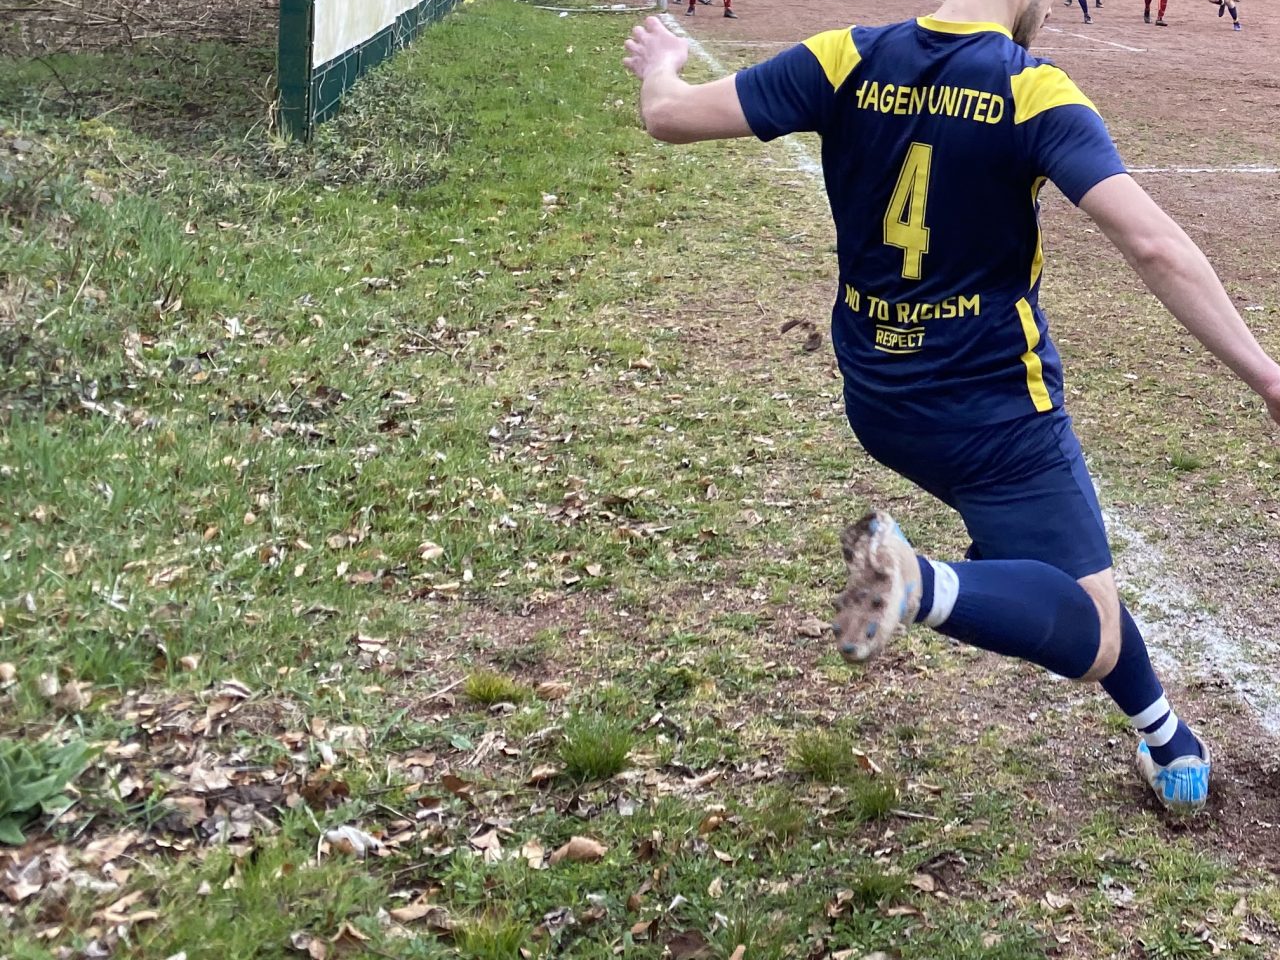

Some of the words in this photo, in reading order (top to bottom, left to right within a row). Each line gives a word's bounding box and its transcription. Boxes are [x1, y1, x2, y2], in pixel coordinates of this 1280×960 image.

[855, 80, 927, 115] HAGEN
[928, 85, 1004, 124] UNITED
[882, 141, 933, 281] 4
[844, 283, 860, 313] NO
[867, 295, 890, 321] TO
[895, 293, 980, 324] RACISM
[875, 329, 925, 348] RESPECT
